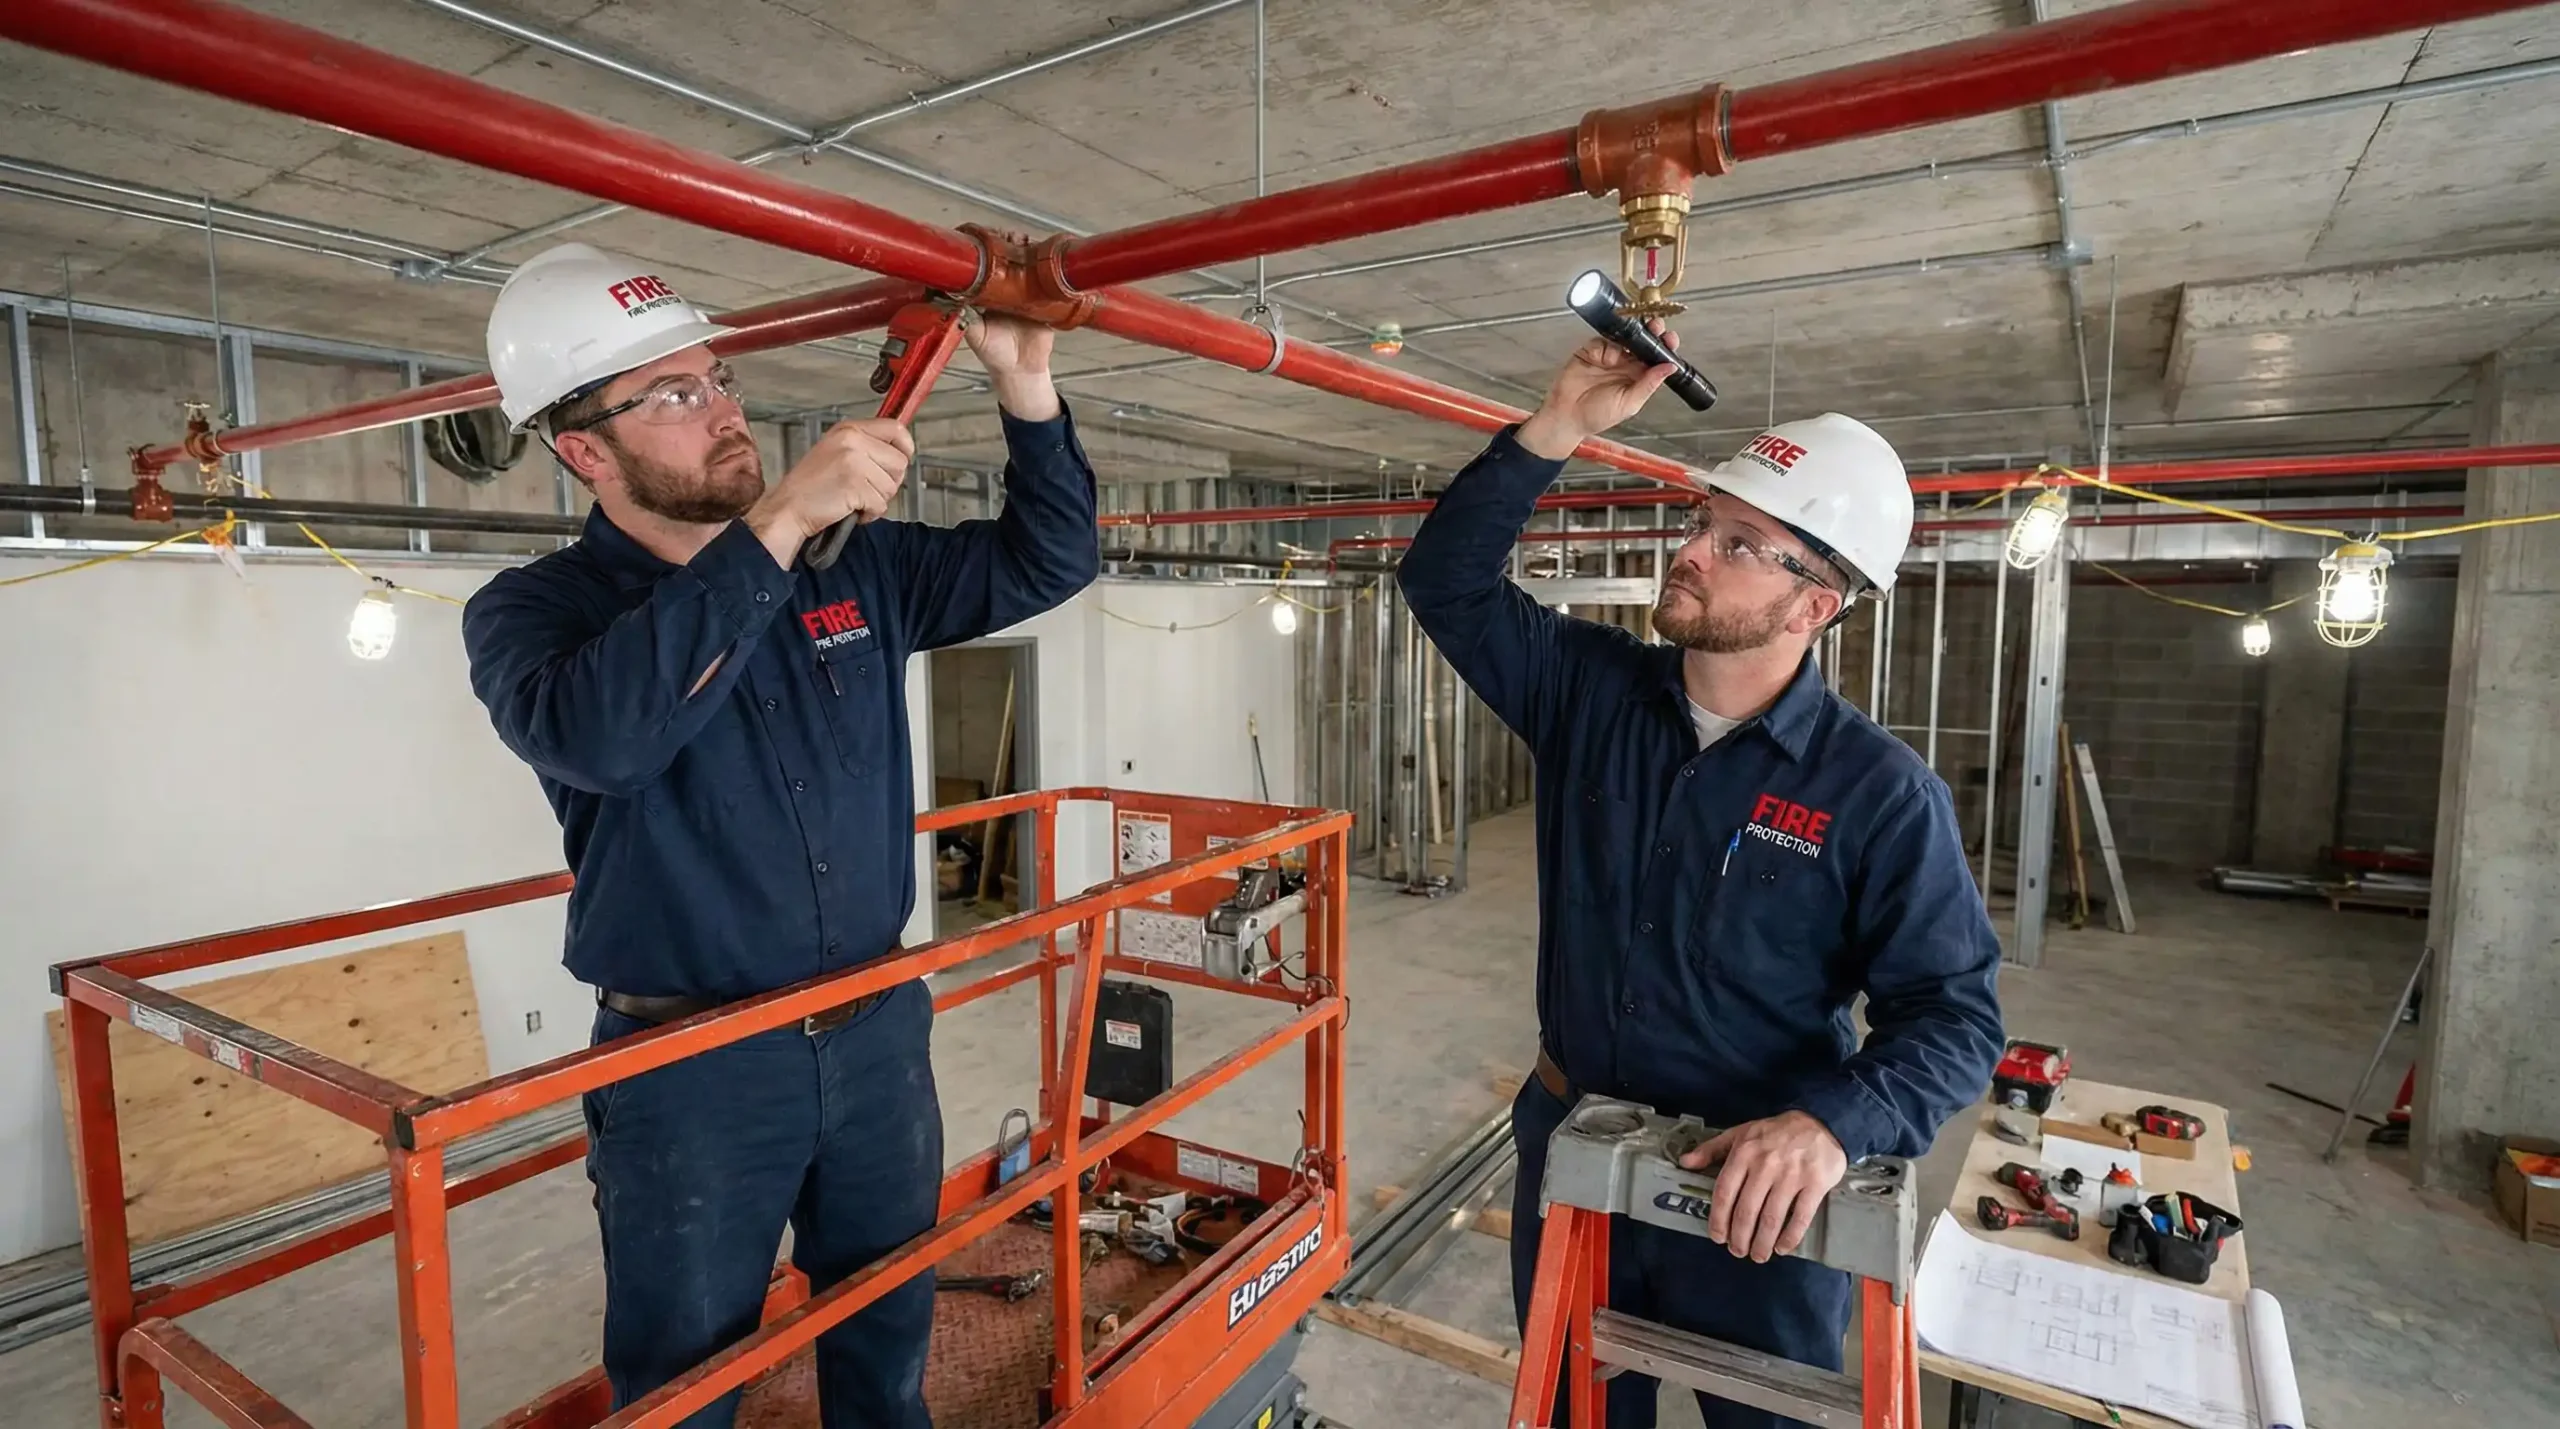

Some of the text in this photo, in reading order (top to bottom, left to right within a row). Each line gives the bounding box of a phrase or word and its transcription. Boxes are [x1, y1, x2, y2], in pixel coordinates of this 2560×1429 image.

[607, 275, 676, 309] FIRE
[1743, 434, 1808, 468] FIRE
[801, 600, 867, 639] FIRE
[1751, 792, 1832, 844] FIRE
[1745, 822, 1821, 859] PROTECTION
